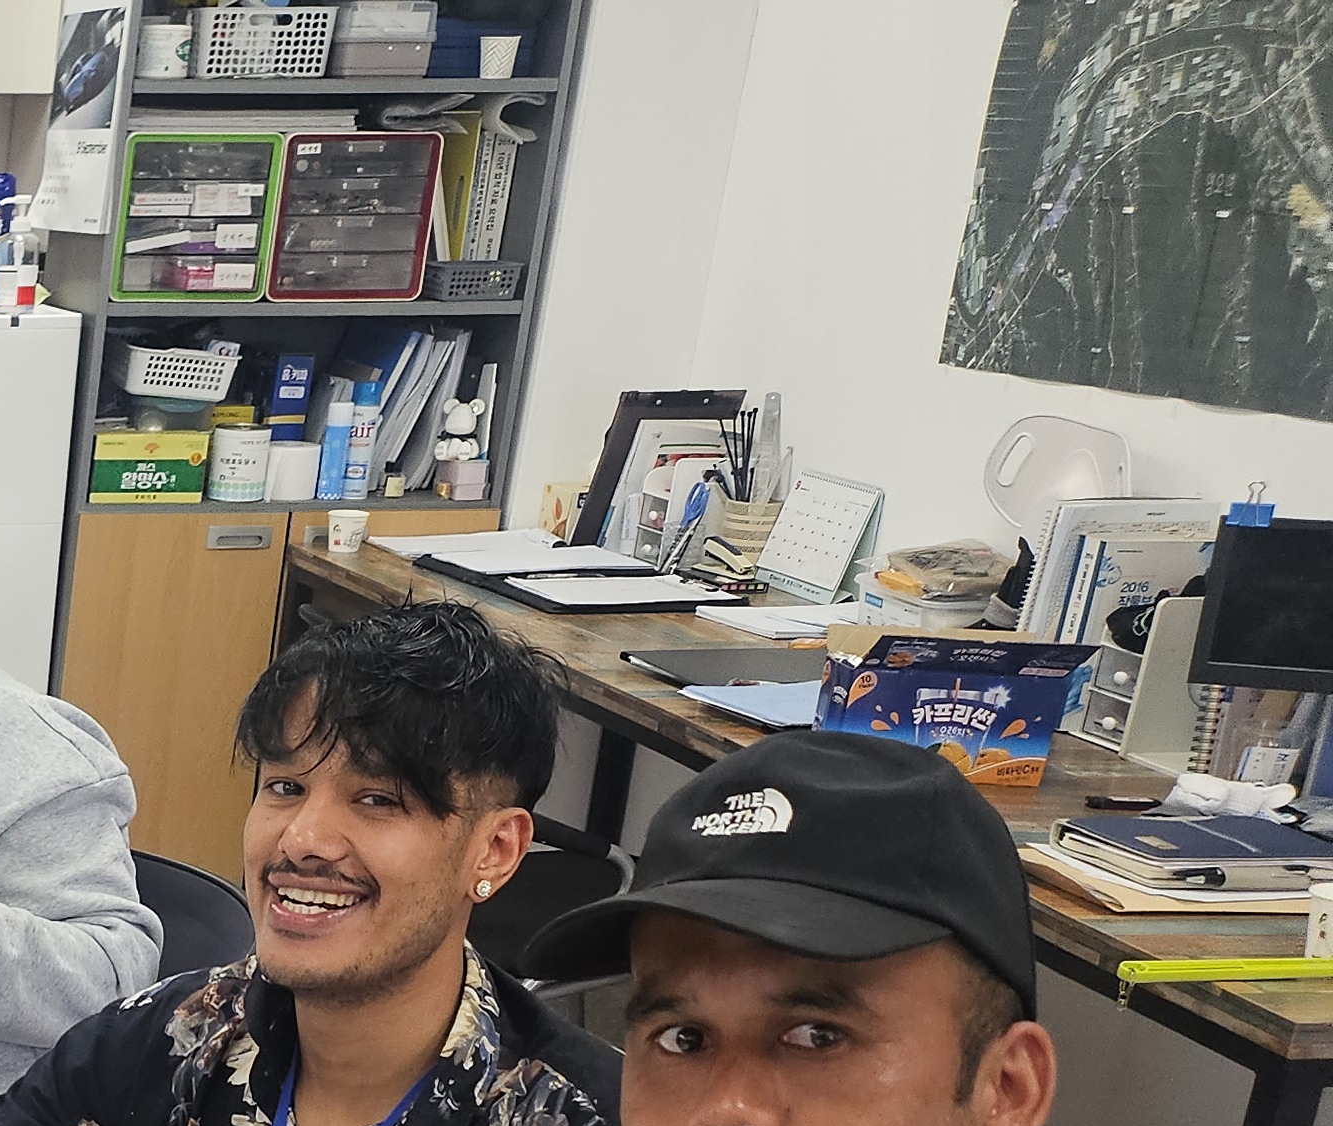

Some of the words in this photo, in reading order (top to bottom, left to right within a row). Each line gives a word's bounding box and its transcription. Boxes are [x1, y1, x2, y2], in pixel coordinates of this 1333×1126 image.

[121, 471, 169, 490] 활명수
[1121, 582, 1149, 593] 2016
[861, 675, 871, 683] 10
[912, 703, 997, 731] 카프리썬
[939, 726, 965, 737] 오렌지
[724, 791, 764, 810] THE
[692, 807, 760, 830] NORTH
[701, 822, 753, 836] FACE
